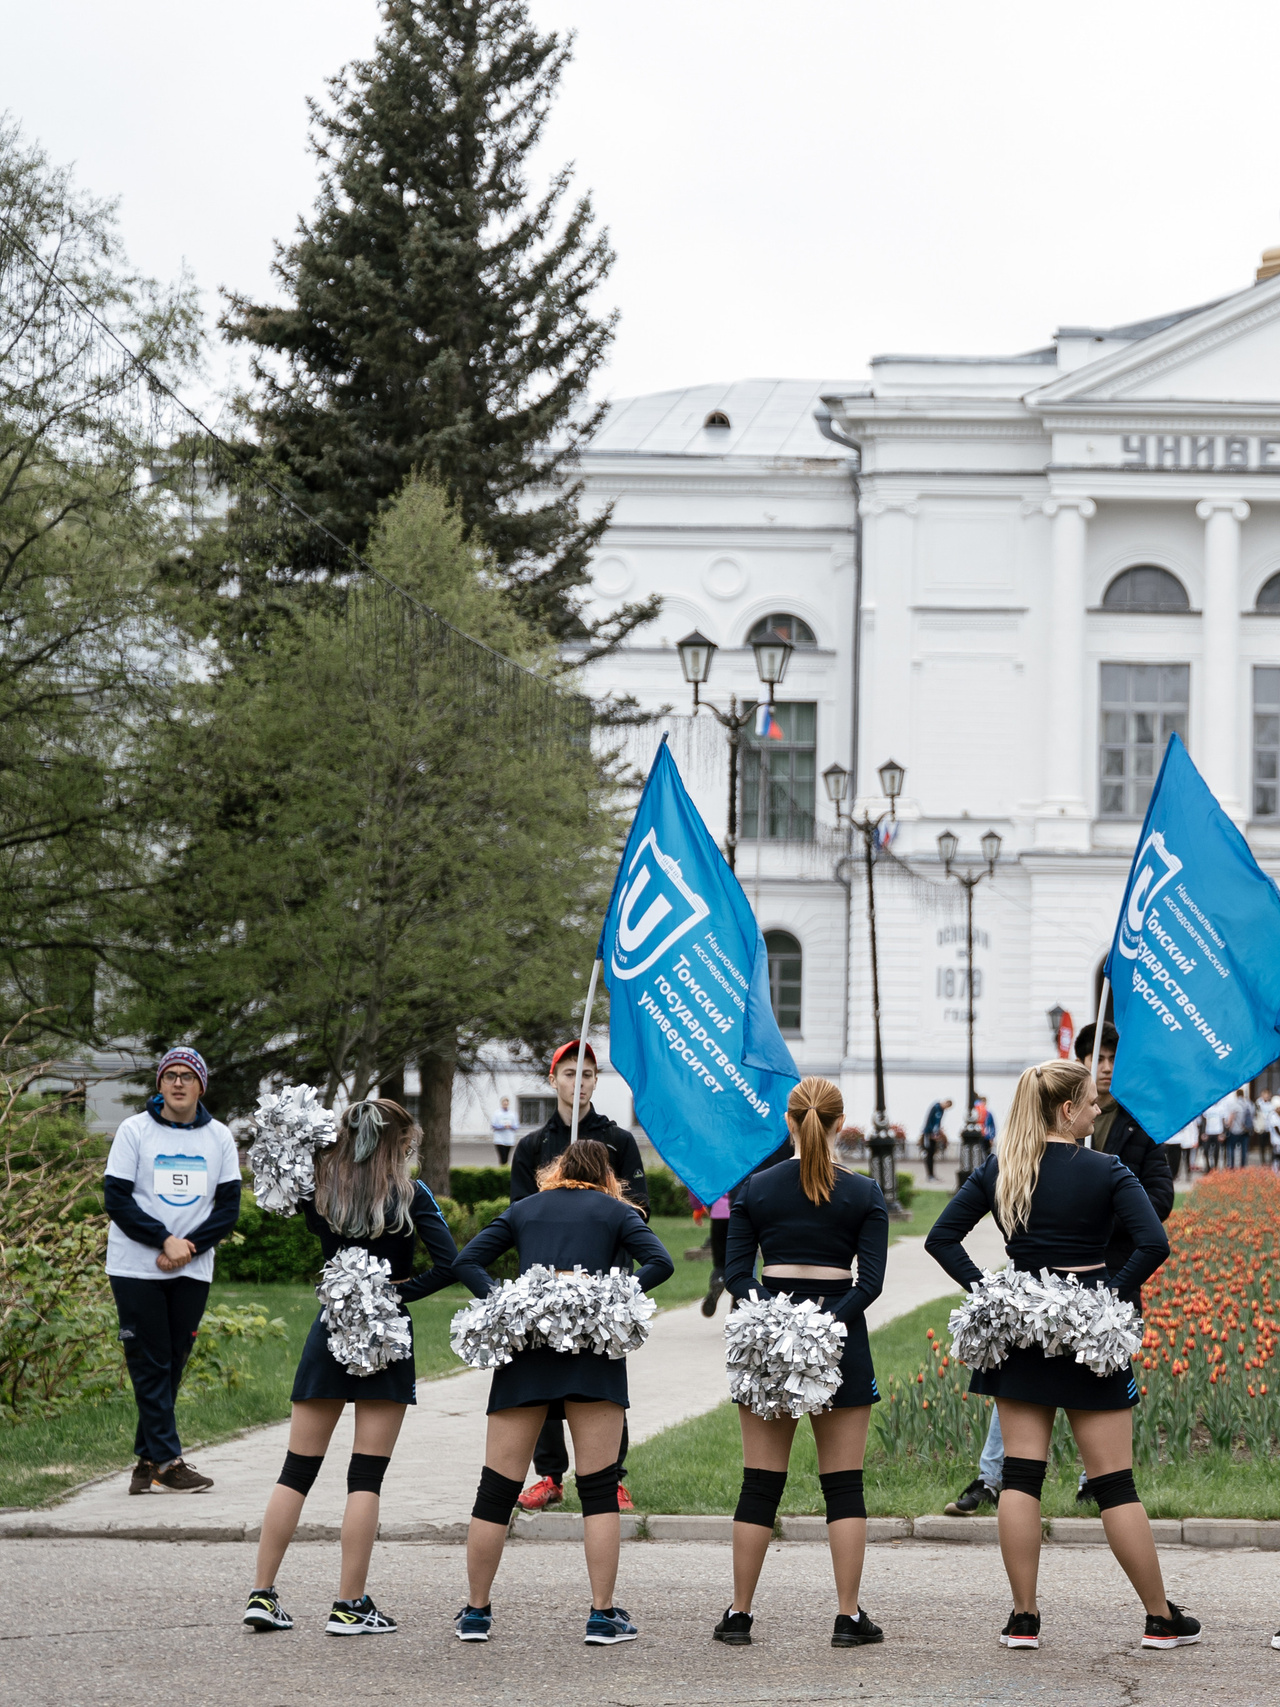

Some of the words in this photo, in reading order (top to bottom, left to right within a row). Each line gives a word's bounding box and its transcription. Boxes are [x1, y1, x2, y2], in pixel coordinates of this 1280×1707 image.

[1145, 908, 1197, 975] Томский
[1163, 895, 1230, 979] исследовательский
[1175, 883, 1227, 950] Национальный
[672, 954, 735, 1034] Томский
[692, 942, 745, 1013] исследовател
[704, 931, 749, 992] Национальн
[937, 967, 982, 998] 1878
[1132, 966, 1183, 1032] ерситет
[1138, 934, 1232, 1060] сударственный
[637, 990, 725, 1094] университет
[654, 974, 771, 1118] государственный
[172, 1174, 189, 1186] 51
